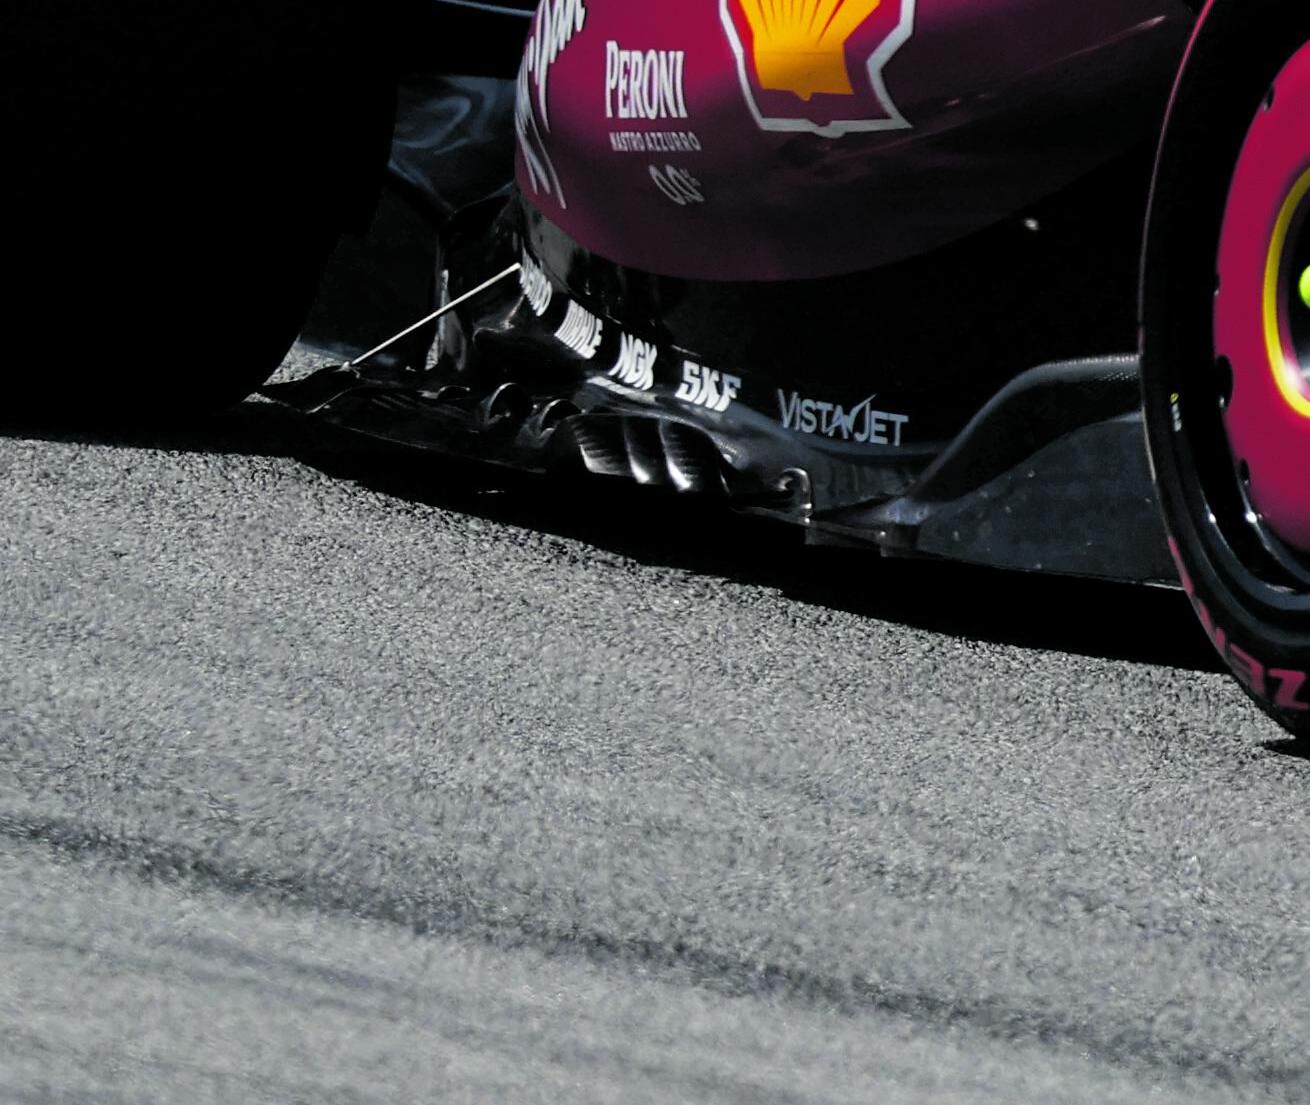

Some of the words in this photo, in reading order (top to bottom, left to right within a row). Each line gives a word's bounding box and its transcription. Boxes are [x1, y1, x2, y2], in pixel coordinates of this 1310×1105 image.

[605, 40, 688, 120] PERONI
[645, 131, 702, 152] AZZURRO
[607, 330, 659, 391] NGK
[674, 359, 742, 413] SKF
